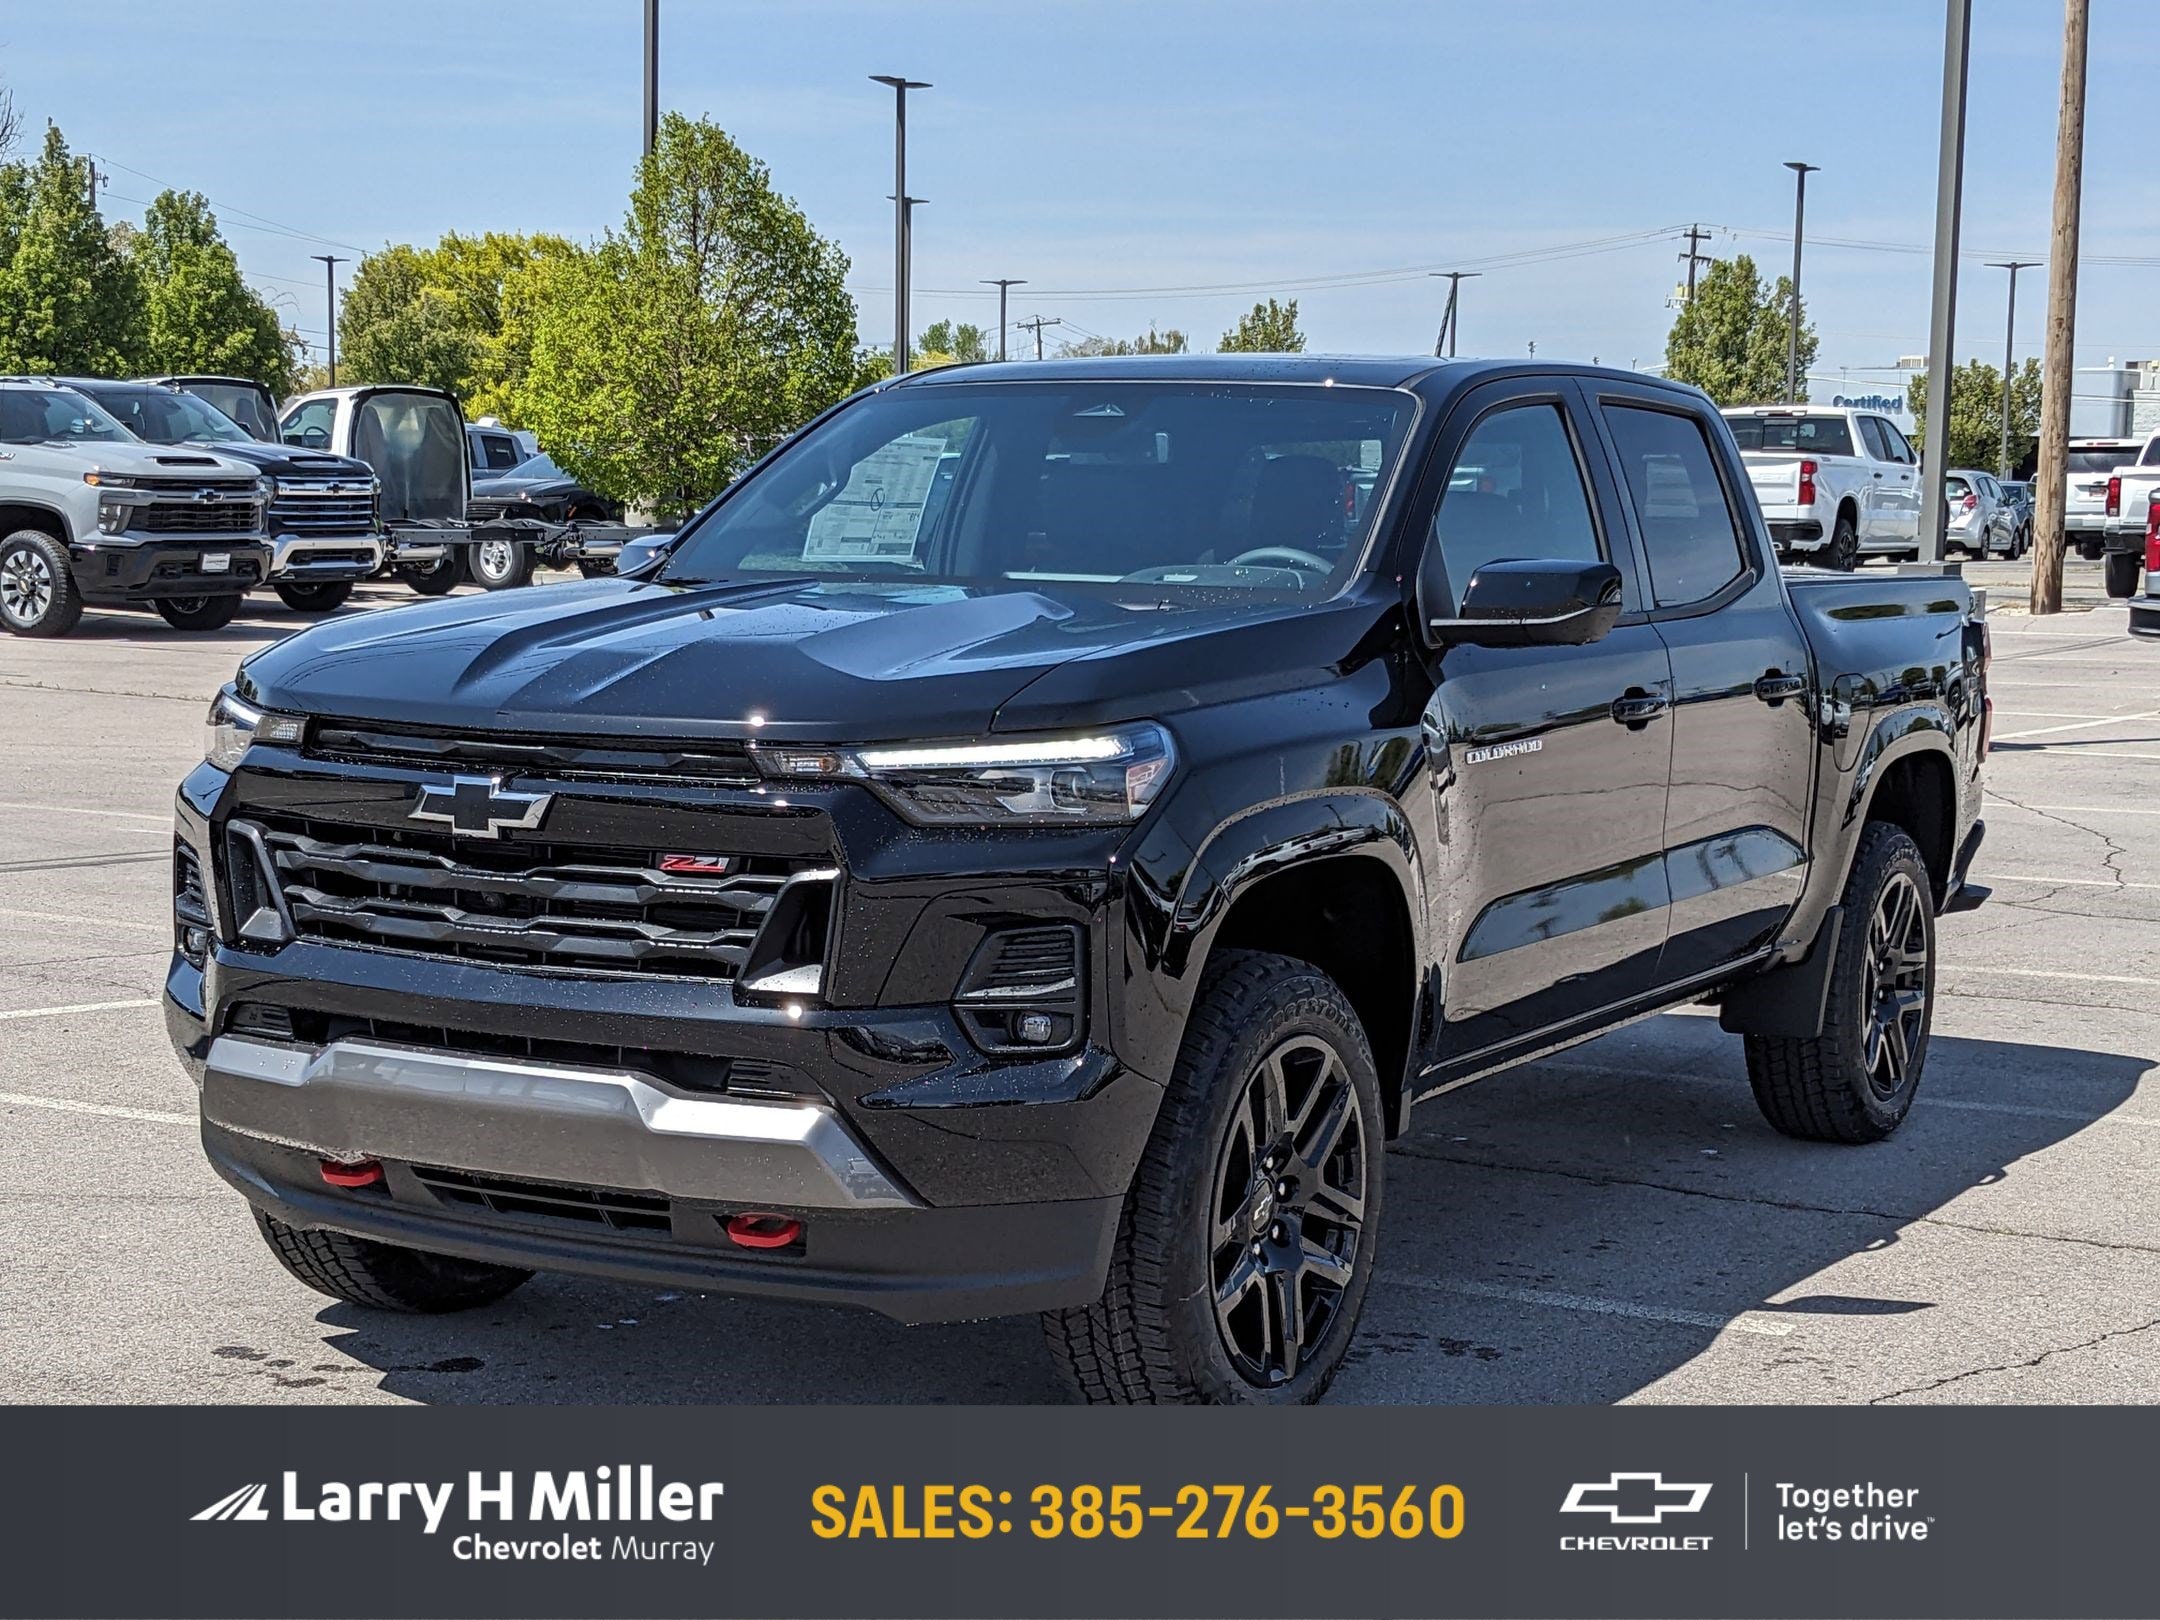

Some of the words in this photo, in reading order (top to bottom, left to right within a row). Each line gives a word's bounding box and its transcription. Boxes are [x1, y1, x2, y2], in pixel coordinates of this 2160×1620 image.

[1833, 395, 1903, 412] Certified
[1465, 739, 1543, 764] COLORADO
[659, 854, 730, 873] Z71
